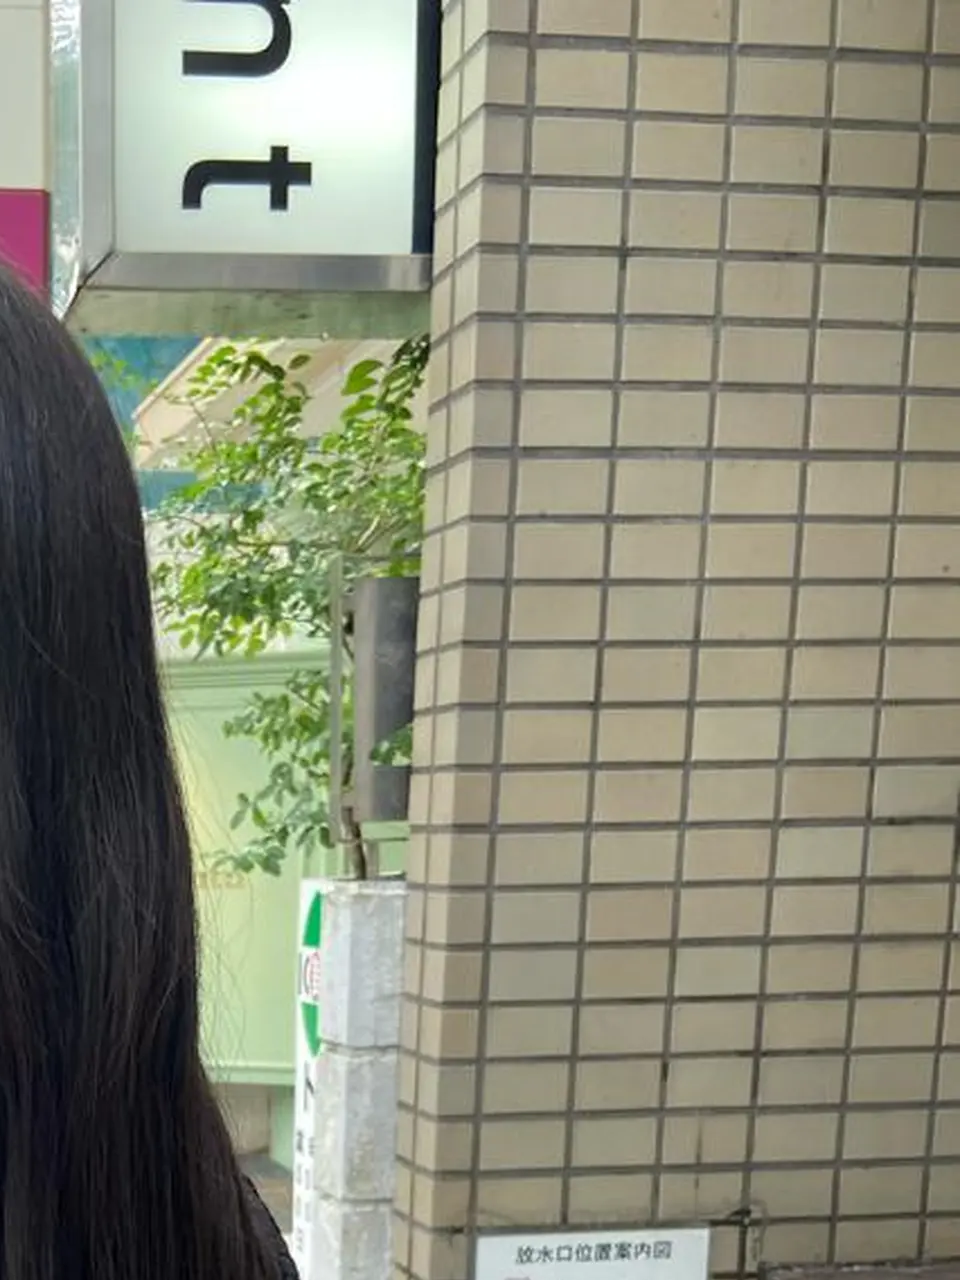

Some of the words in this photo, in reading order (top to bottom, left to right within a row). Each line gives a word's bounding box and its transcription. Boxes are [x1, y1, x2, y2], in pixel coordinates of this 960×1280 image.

[515, 1240, 672, 1265] 放水口位置案内図
